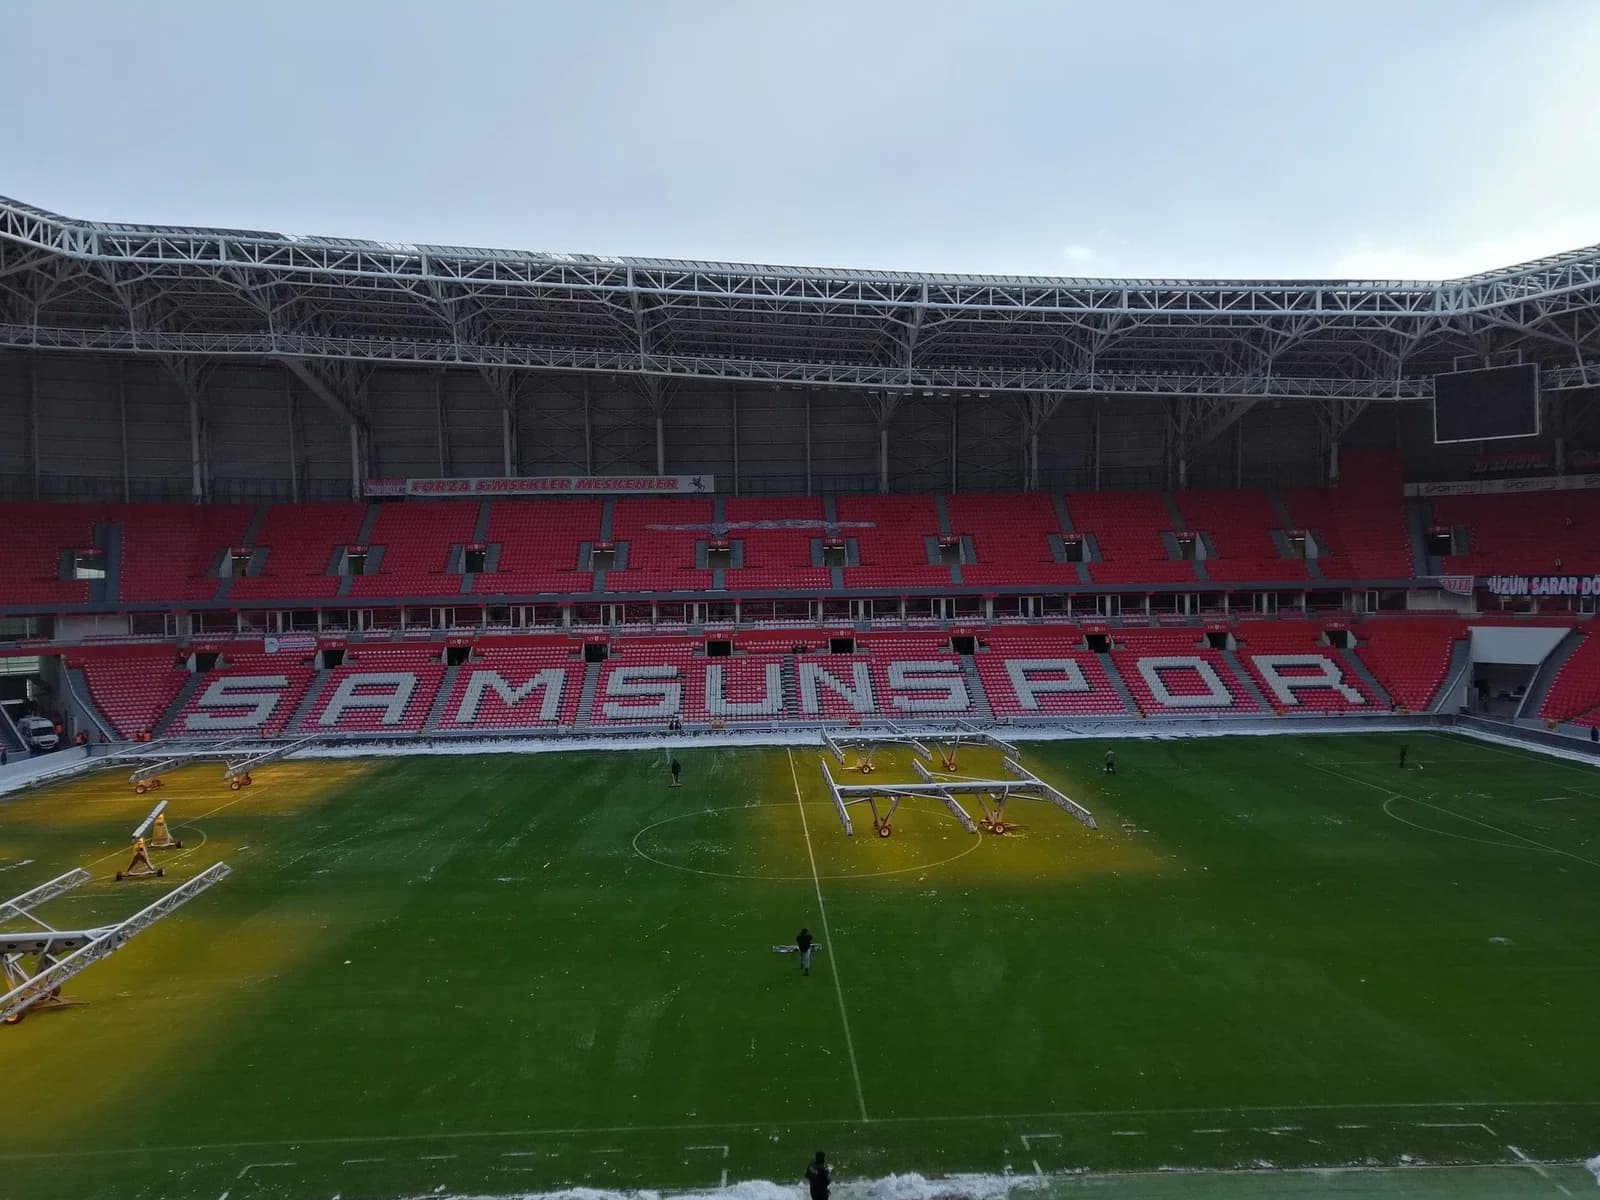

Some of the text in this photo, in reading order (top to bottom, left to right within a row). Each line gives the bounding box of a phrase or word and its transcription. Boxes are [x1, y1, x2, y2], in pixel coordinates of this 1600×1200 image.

[413, 480, 470, 492] FORZA
[1532, 576, 1578, 595] SARAR
[185, 654, 1368, 731] SAMSUNSPOR
